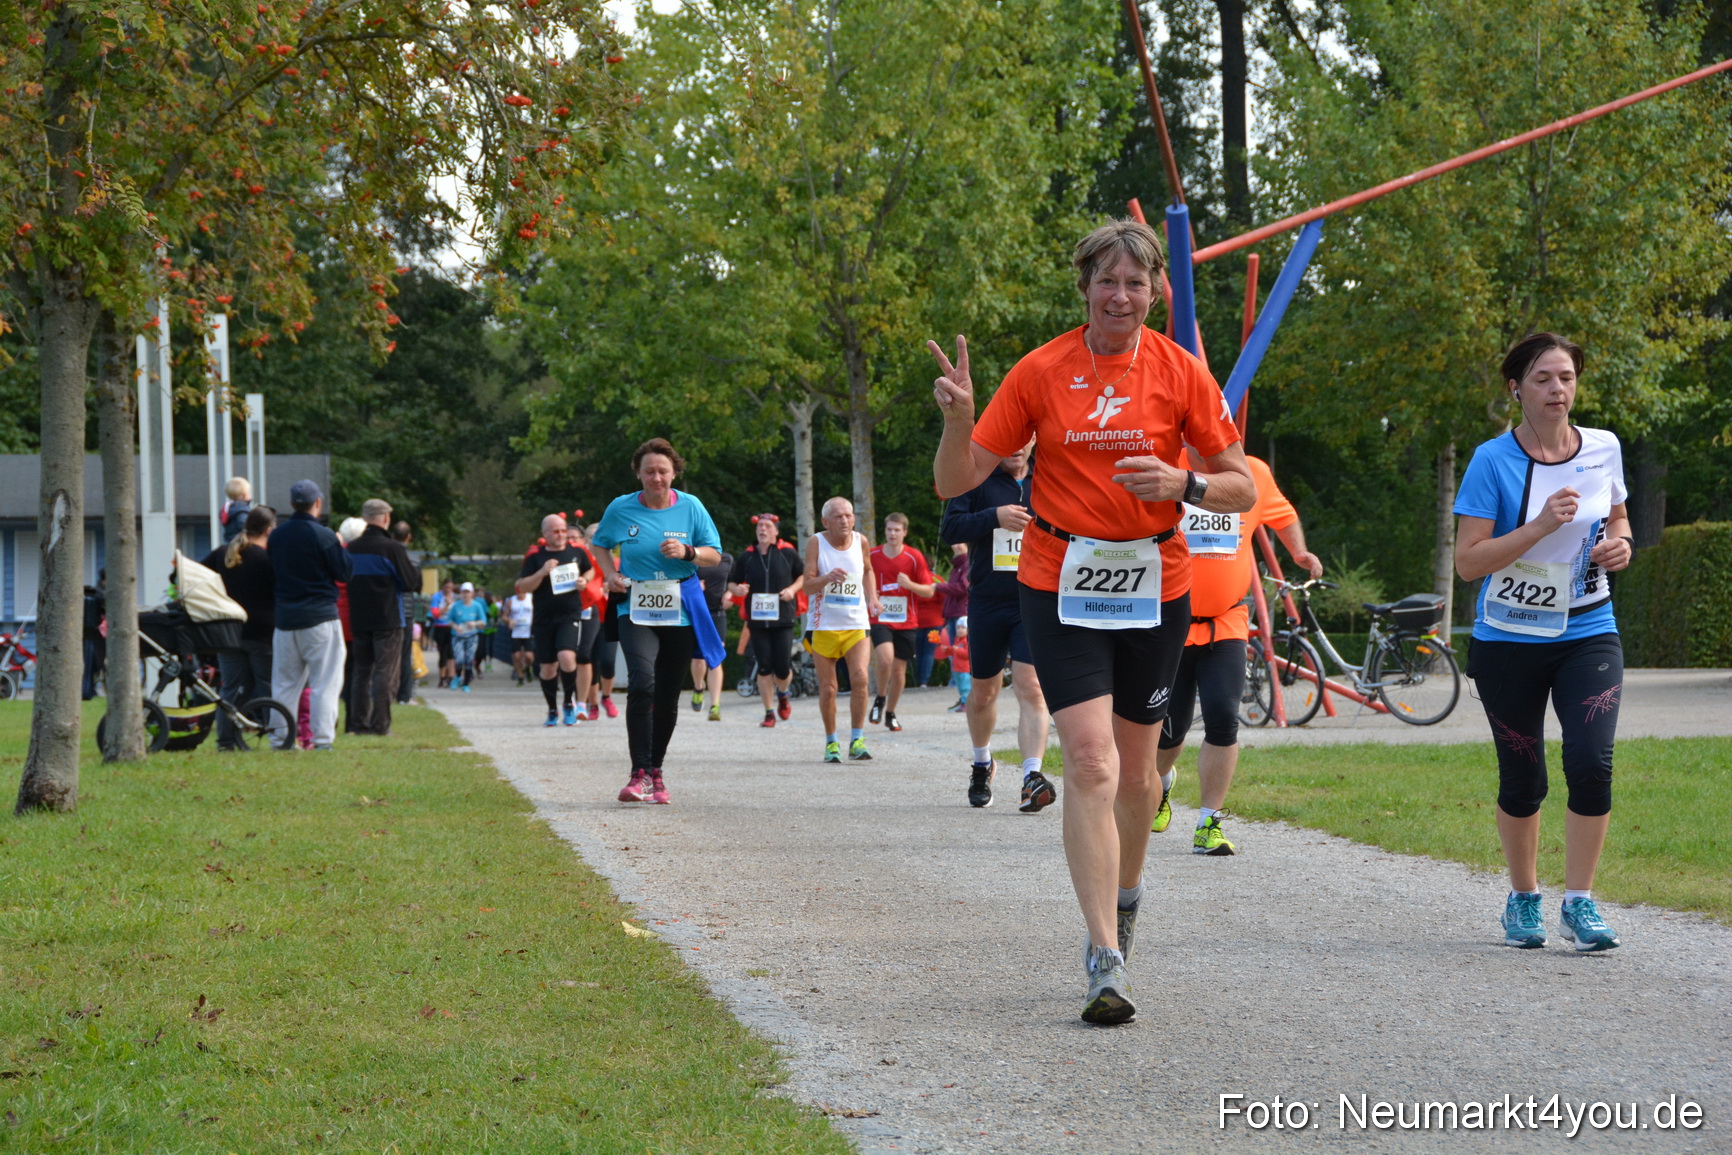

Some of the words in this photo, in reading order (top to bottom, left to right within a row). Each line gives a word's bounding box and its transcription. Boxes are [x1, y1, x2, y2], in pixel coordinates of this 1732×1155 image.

[1064, 429, 1144, 445] funrunners
[1089, 438, 1155, 451] neumarkt
[1189, 514, 1231, 531] 2586
[1201, 536, 1221, 544] Walter
[1104, 550, 1137, 558] BOCK
[1074, 566, 1147, 593] 2227
[830, 583, 857, 595] 2182
[1497, 576, 1557, 608] 2422
[638, 594, 673, 608] 2302
[755, 601, 775, 610] 2139
[883, 604, 903, 613] 2455
[1085, 601, 1133, 615] Hildegard
[1506, 610, 1538, 621] Andrea
